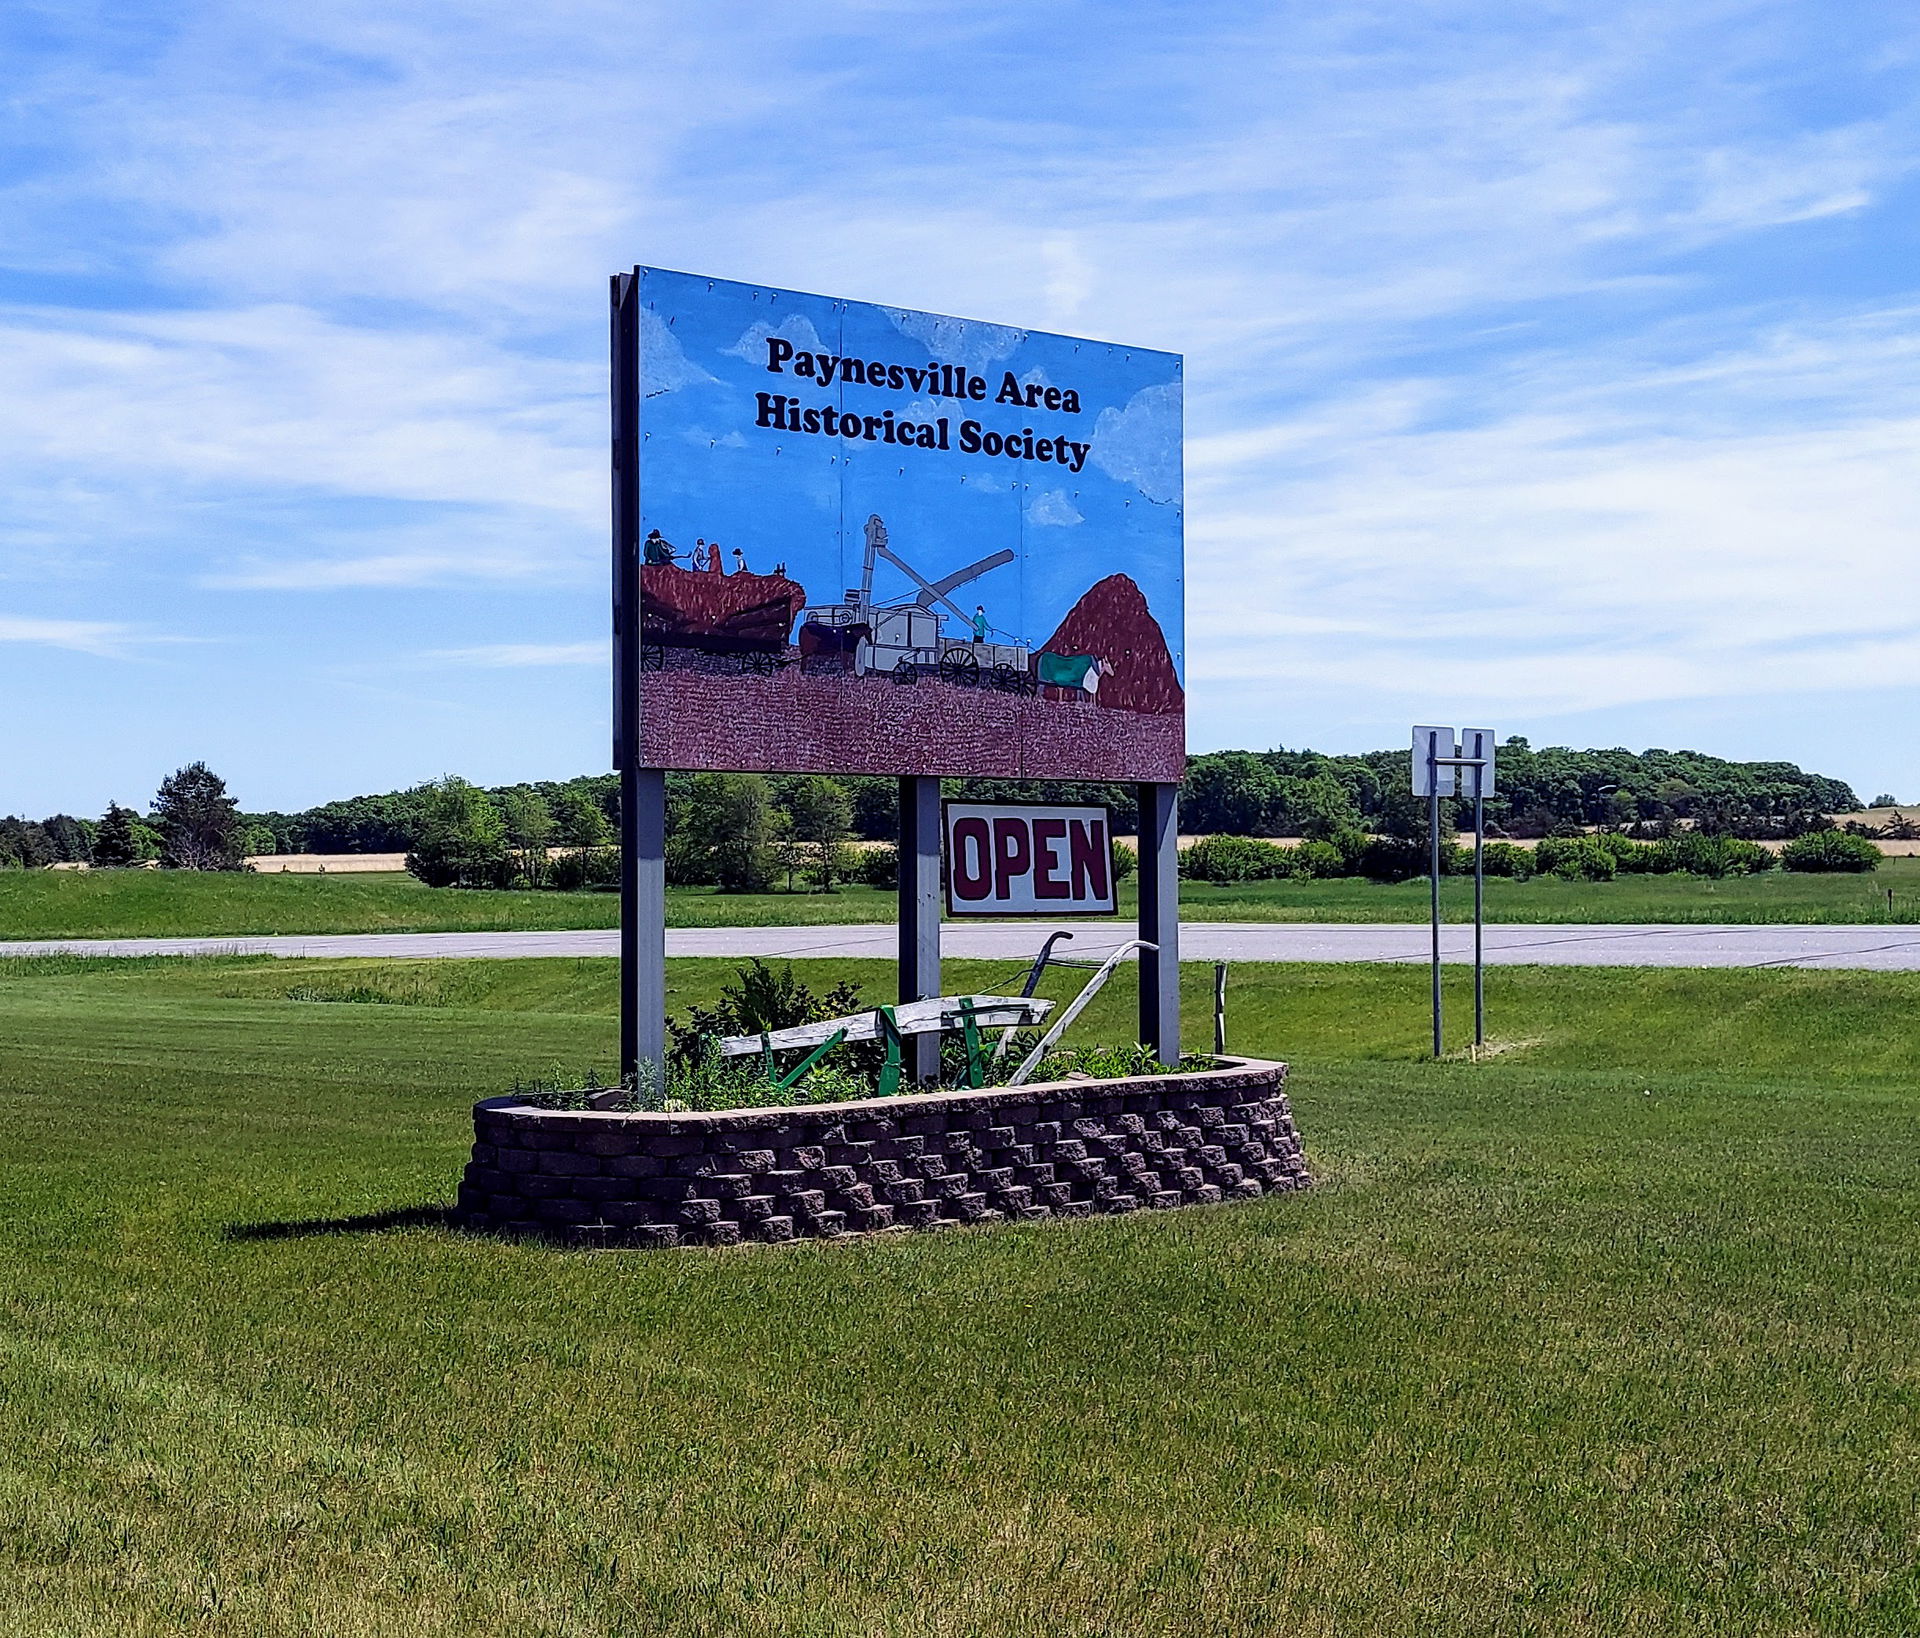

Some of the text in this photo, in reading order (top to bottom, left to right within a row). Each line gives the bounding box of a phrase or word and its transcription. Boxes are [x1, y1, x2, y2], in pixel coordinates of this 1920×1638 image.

[766, 337, 1081, 413] Paynesville Area
[755, 392, 1091, 473] Historical Society
[953, 817, 1109, 901] OPEN
